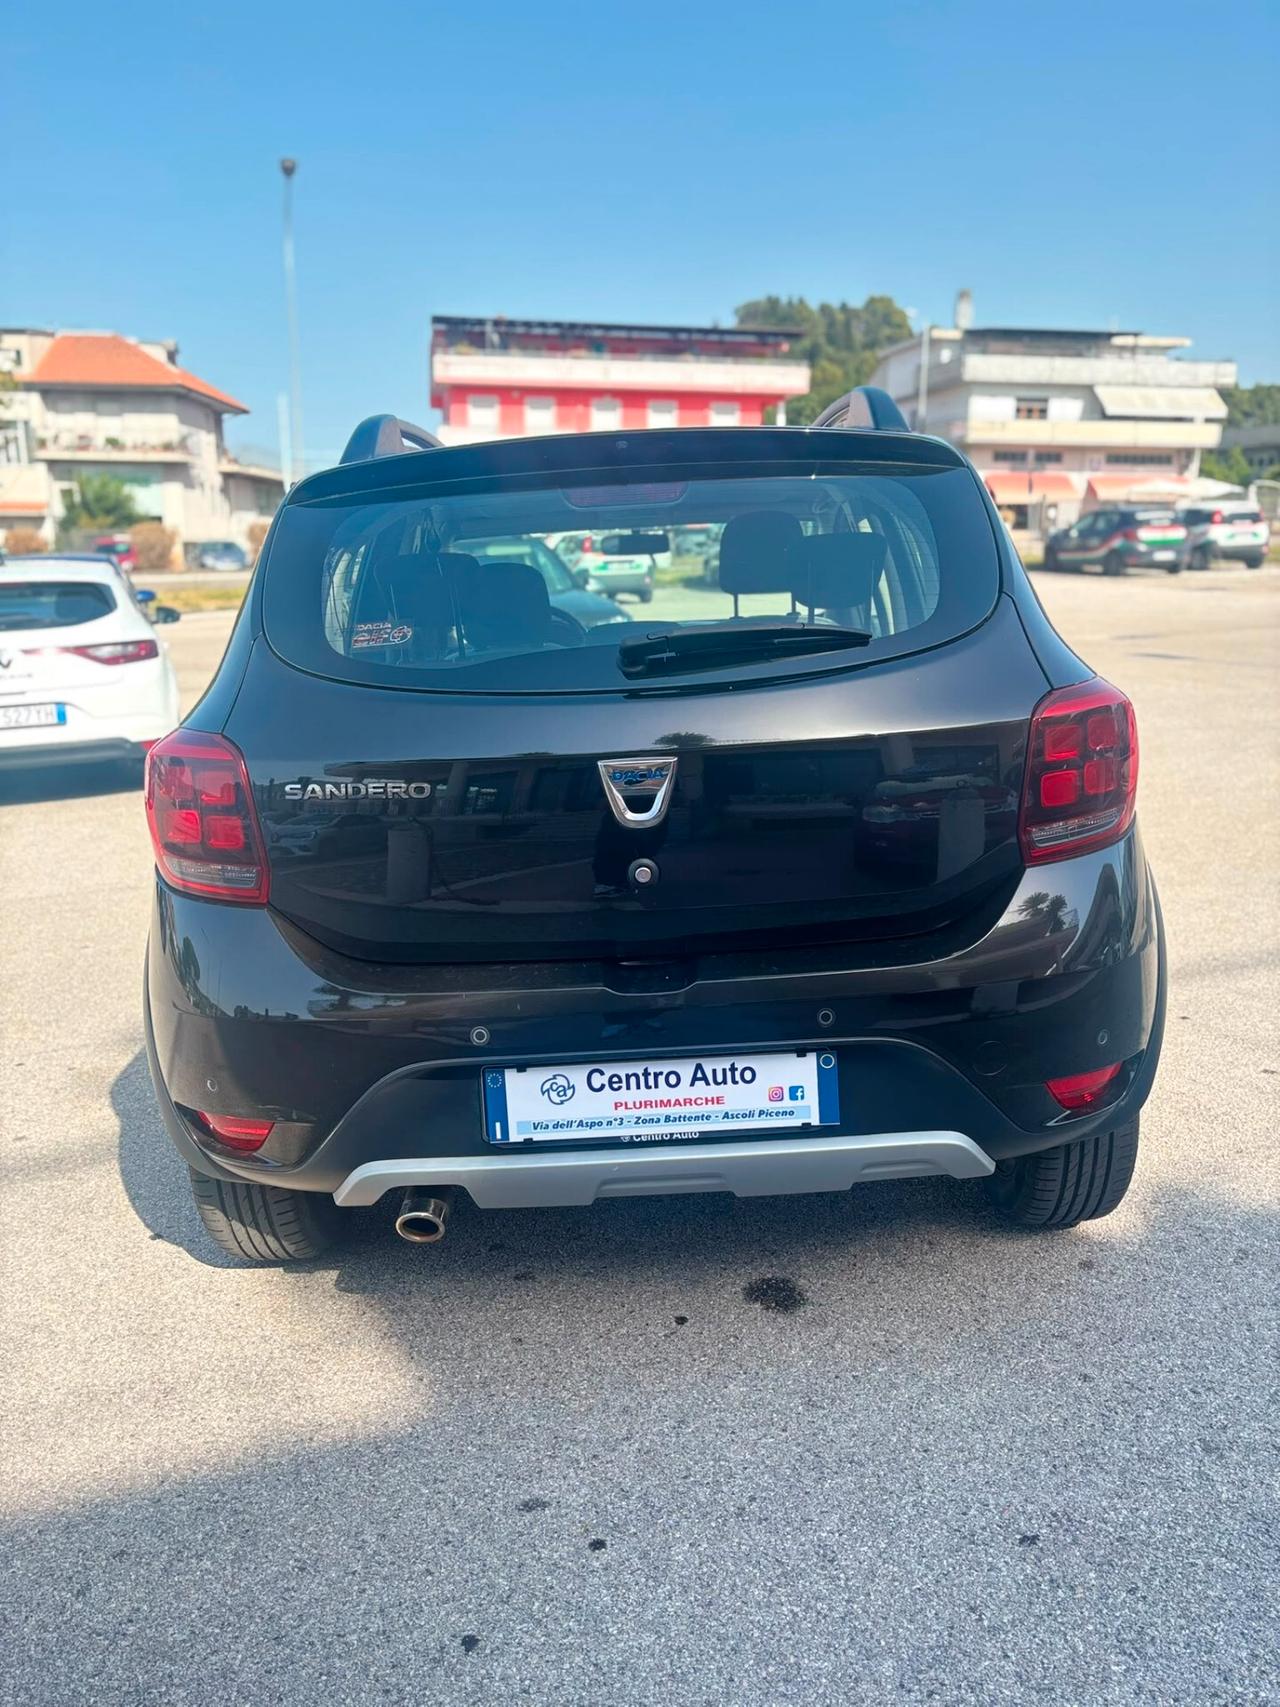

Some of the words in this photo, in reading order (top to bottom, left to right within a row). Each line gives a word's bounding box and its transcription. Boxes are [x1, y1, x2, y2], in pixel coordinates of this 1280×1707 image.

[284, 782, 431, 800] SANDERO
[586, 1067, 681, 1093] Centro
[689, 1061, 757, 1087] Auto
[613, 1096, 725, 1110] PLURIMARCHE
[532, 1121, 549, 1131] Via
[552, 1117, 603, 1130] dell'Aspo
[605, 1117, 624, 1127] n°3
[634, 1116, 660, 1125] Zona
[664, 1113, 711, 1124] Battente
[722, 1110, 755, 1120] Ascoli
[758, 1109, 795, 1118] Piceno
